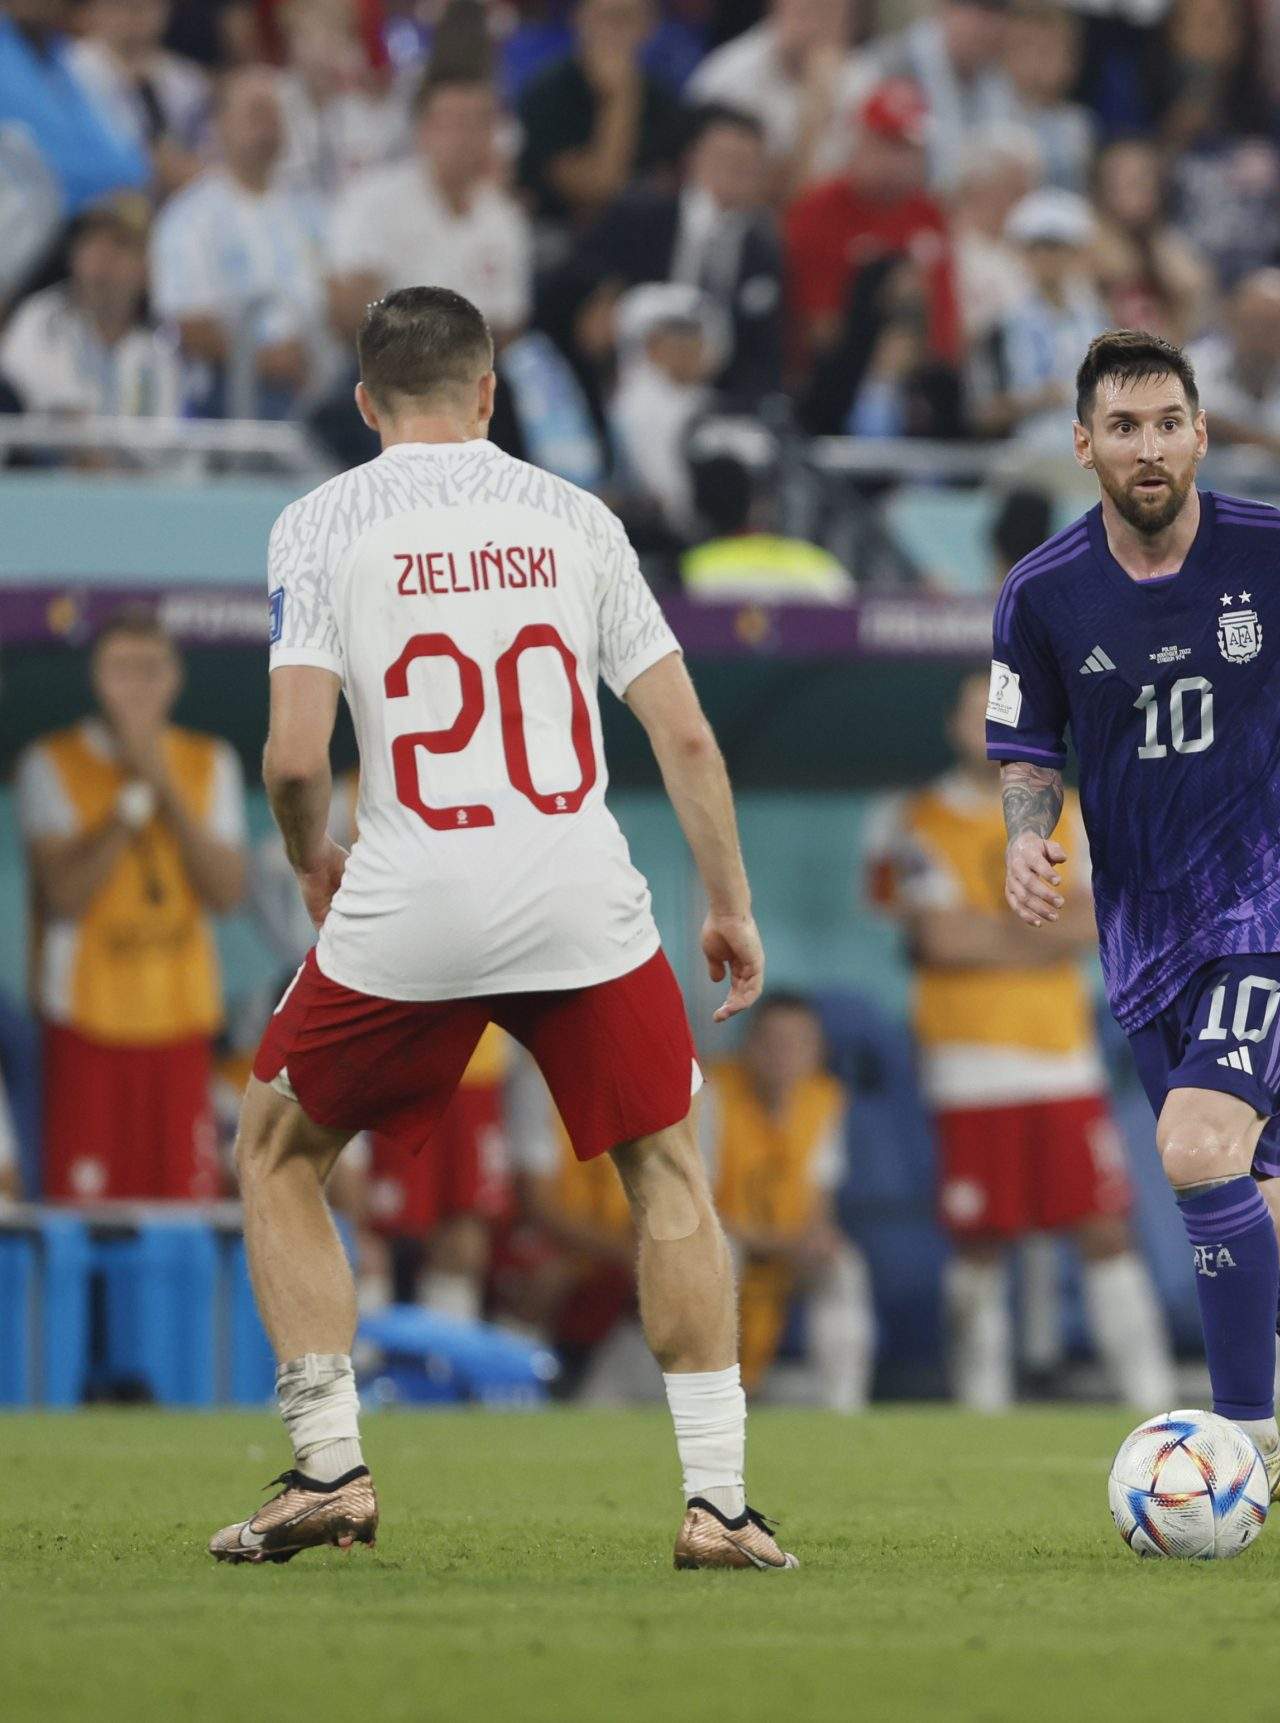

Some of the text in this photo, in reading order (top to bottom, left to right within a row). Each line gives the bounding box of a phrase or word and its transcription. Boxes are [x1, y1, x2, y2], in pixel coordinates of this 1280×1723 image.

[394, 541, 557, 596] ZIELIŃSKI
[1229, 624, 1253, 648] AFA
[384, 623, 597, 831] 20
[1133, 676, 1214, 760] 10
[1193, 1243, 1237, 1277] AFA
